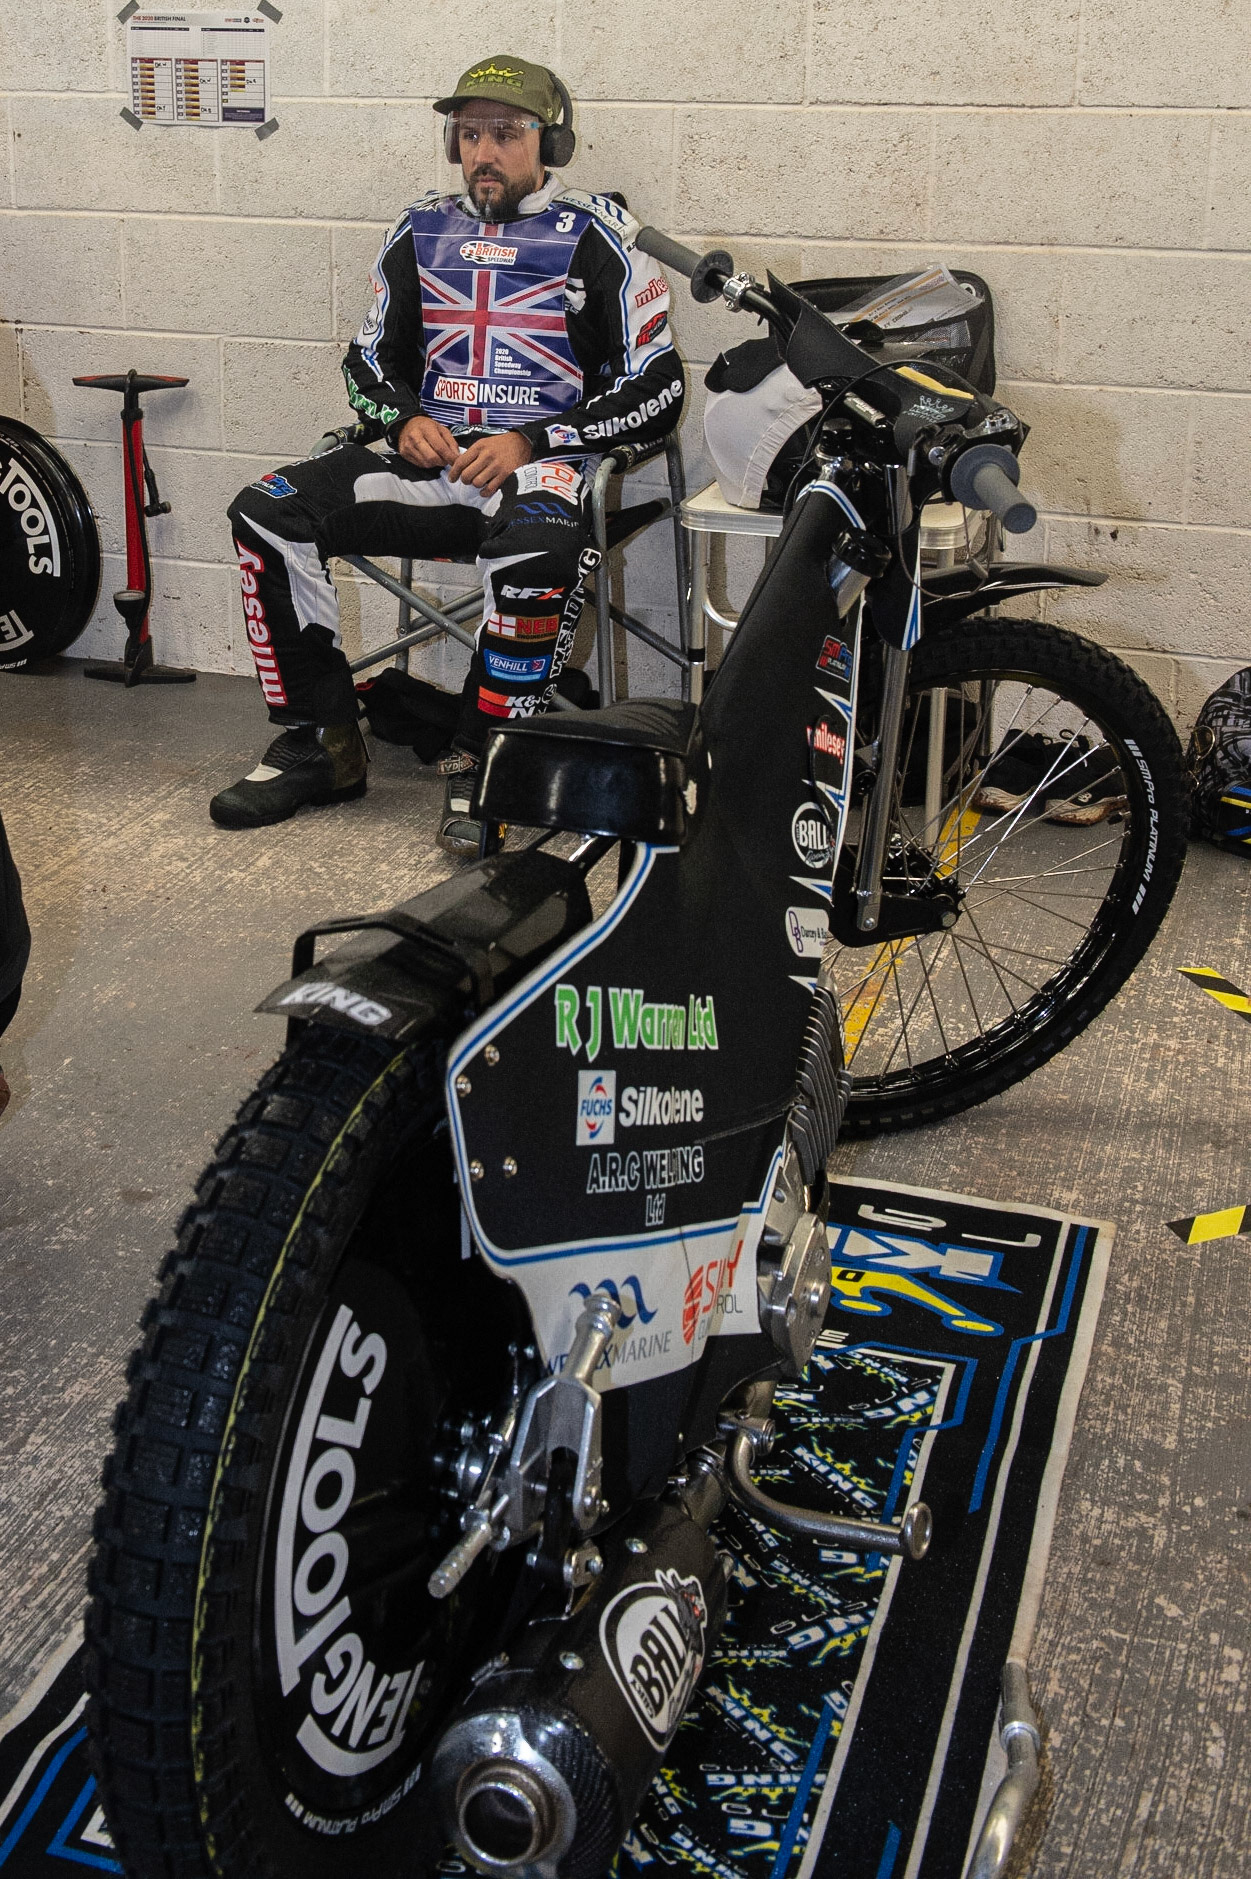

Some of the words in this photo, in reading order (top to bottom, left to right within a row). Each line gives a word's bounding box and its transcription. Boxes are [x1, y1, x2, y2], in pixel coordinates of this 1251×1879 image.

[555, 211, 576, 233] 3
[474, 245, 517, 258] BRITISH
[488, 256, 515, 264] SPEEDWAY
[494, 354, 513, 362] British
[494, 361, 522, 370] Speedway
[494, 367, 532, 377] Championship
[434, 378, 476, 401] SPORTS
[478, 384, 541, 406] INSURE
[235, 538, 288, 707] milesey
[516, 618, 558, 634] NEB
[489, 655, 528, 672] VENHILL
[799, 819, 829, 850] BALL
[1143, 808, 1159, 882] PLATINUM
[276, 982, 393, 1026] KING
[555, 983, 582, 1056] R
[586, 985, 602, 1063] J
[687, 993, 719, 1051] Ltd
[580, 1098, 613, 1117] FUCHS
[618, 1085, 705, 1128] Silkolene
[586, 1151, 641, 1195] A.R.C
[645, 1192, 666, 1227] Ltd
[274, 1302, 388, 1697] TOOLS
[295, 1632, 426, 1777] TENG
[302, 1810, 359, 1836] PLATINUM
